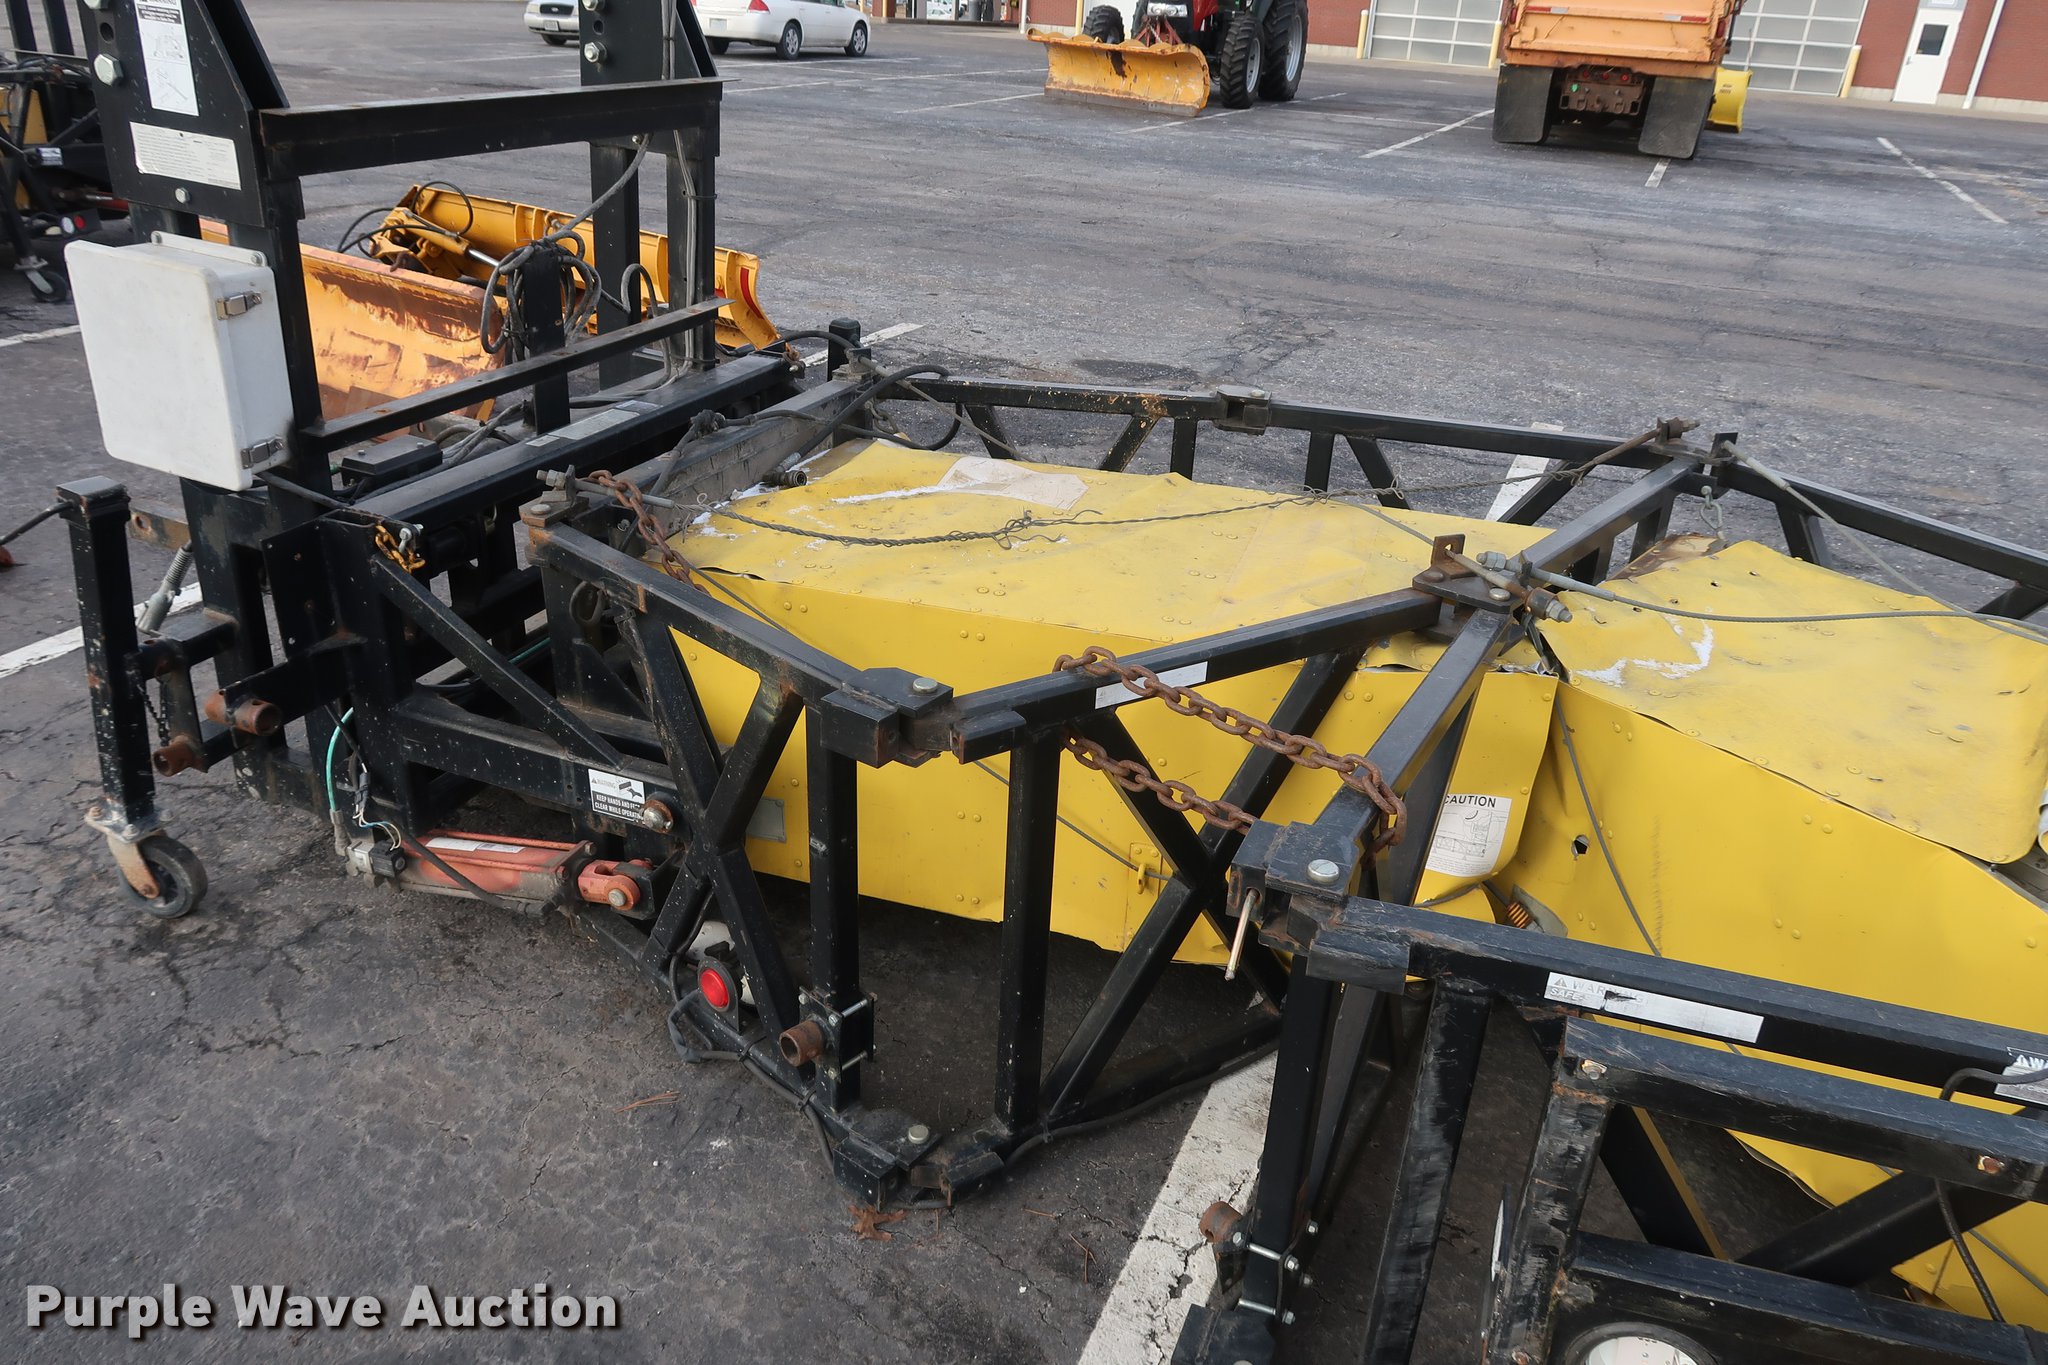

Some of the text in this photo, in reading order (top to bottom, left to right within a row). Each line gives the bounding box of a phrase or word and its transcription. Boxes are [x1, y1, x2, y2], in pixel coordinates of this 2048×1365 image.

[597, 794, 606, 802] KEEP
[607, 797, 621, 806] HANDS
[622, 800, 630, 808] AND
[1444, 795, 1496, 808] CAUTION
[595, 803, 608, 811] CLEAR
[609, 805, 621, 815] WHILE
